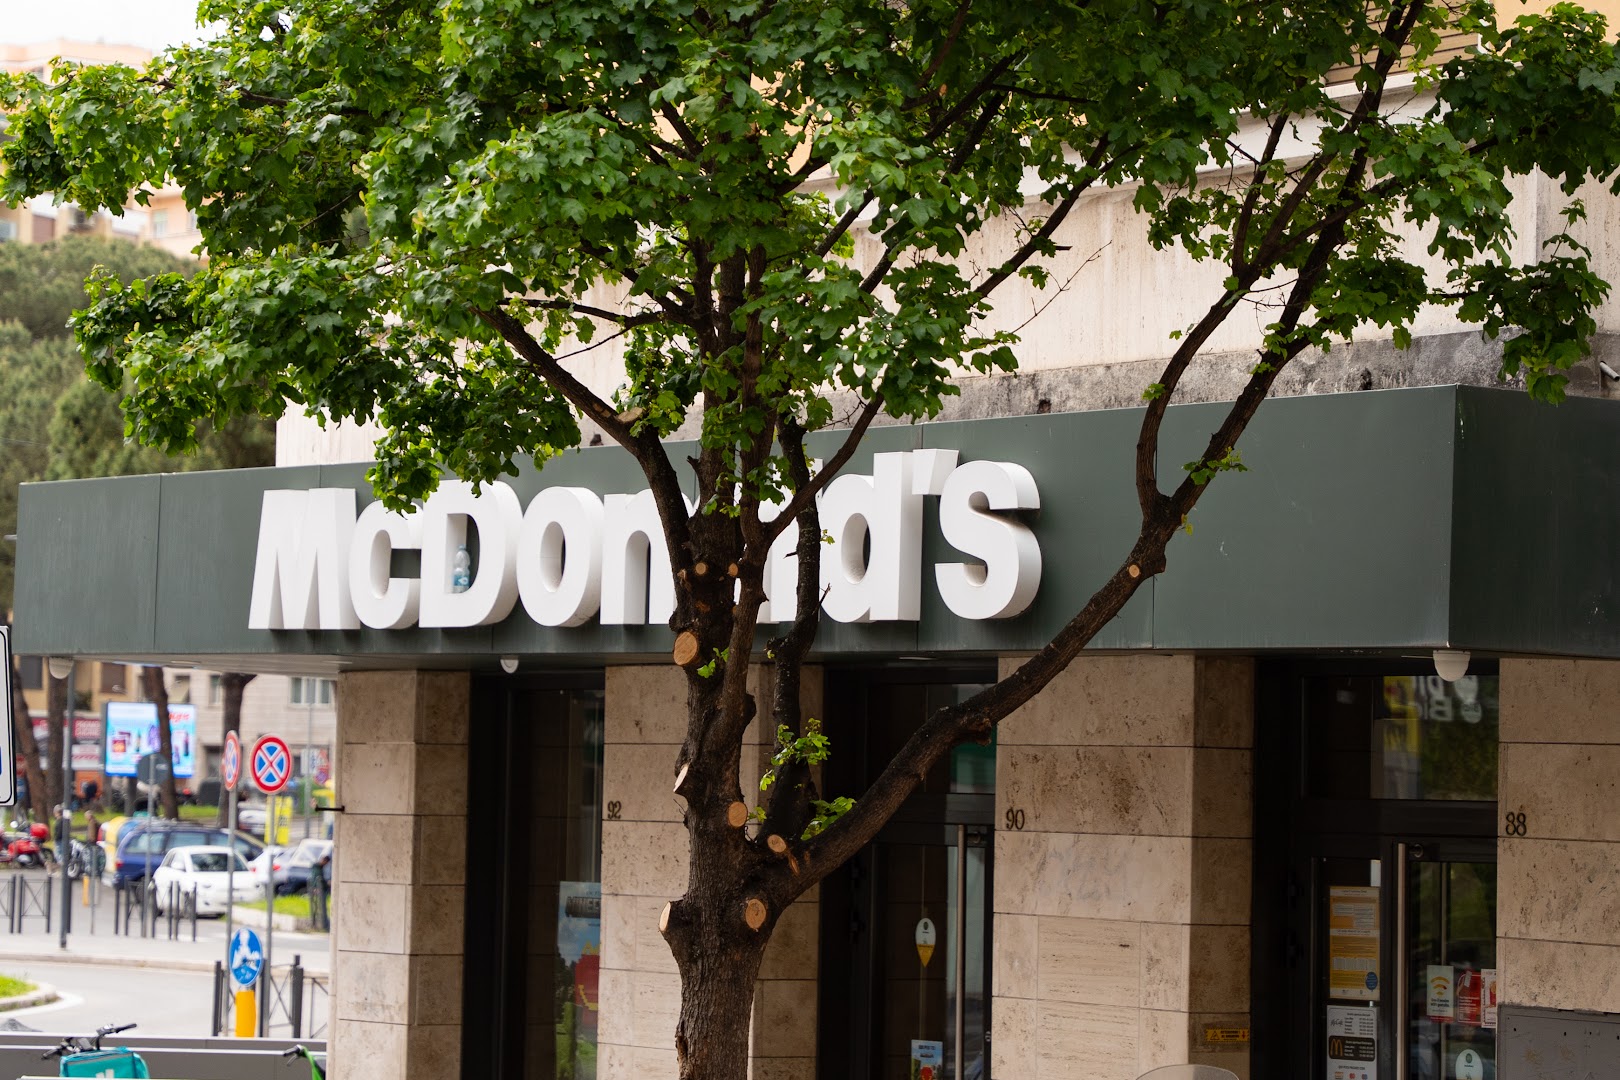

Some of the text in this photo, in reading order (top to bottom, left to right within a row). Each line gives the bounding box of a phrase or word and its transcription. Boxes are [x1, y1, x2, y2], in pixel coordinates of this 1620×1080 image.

[248, 449, 1042, 630] McDonld's
[607, 800, 622, 819] 92
[1006, 808, 1025, 830] 90
[1505, 812, 1527, 836] 88
